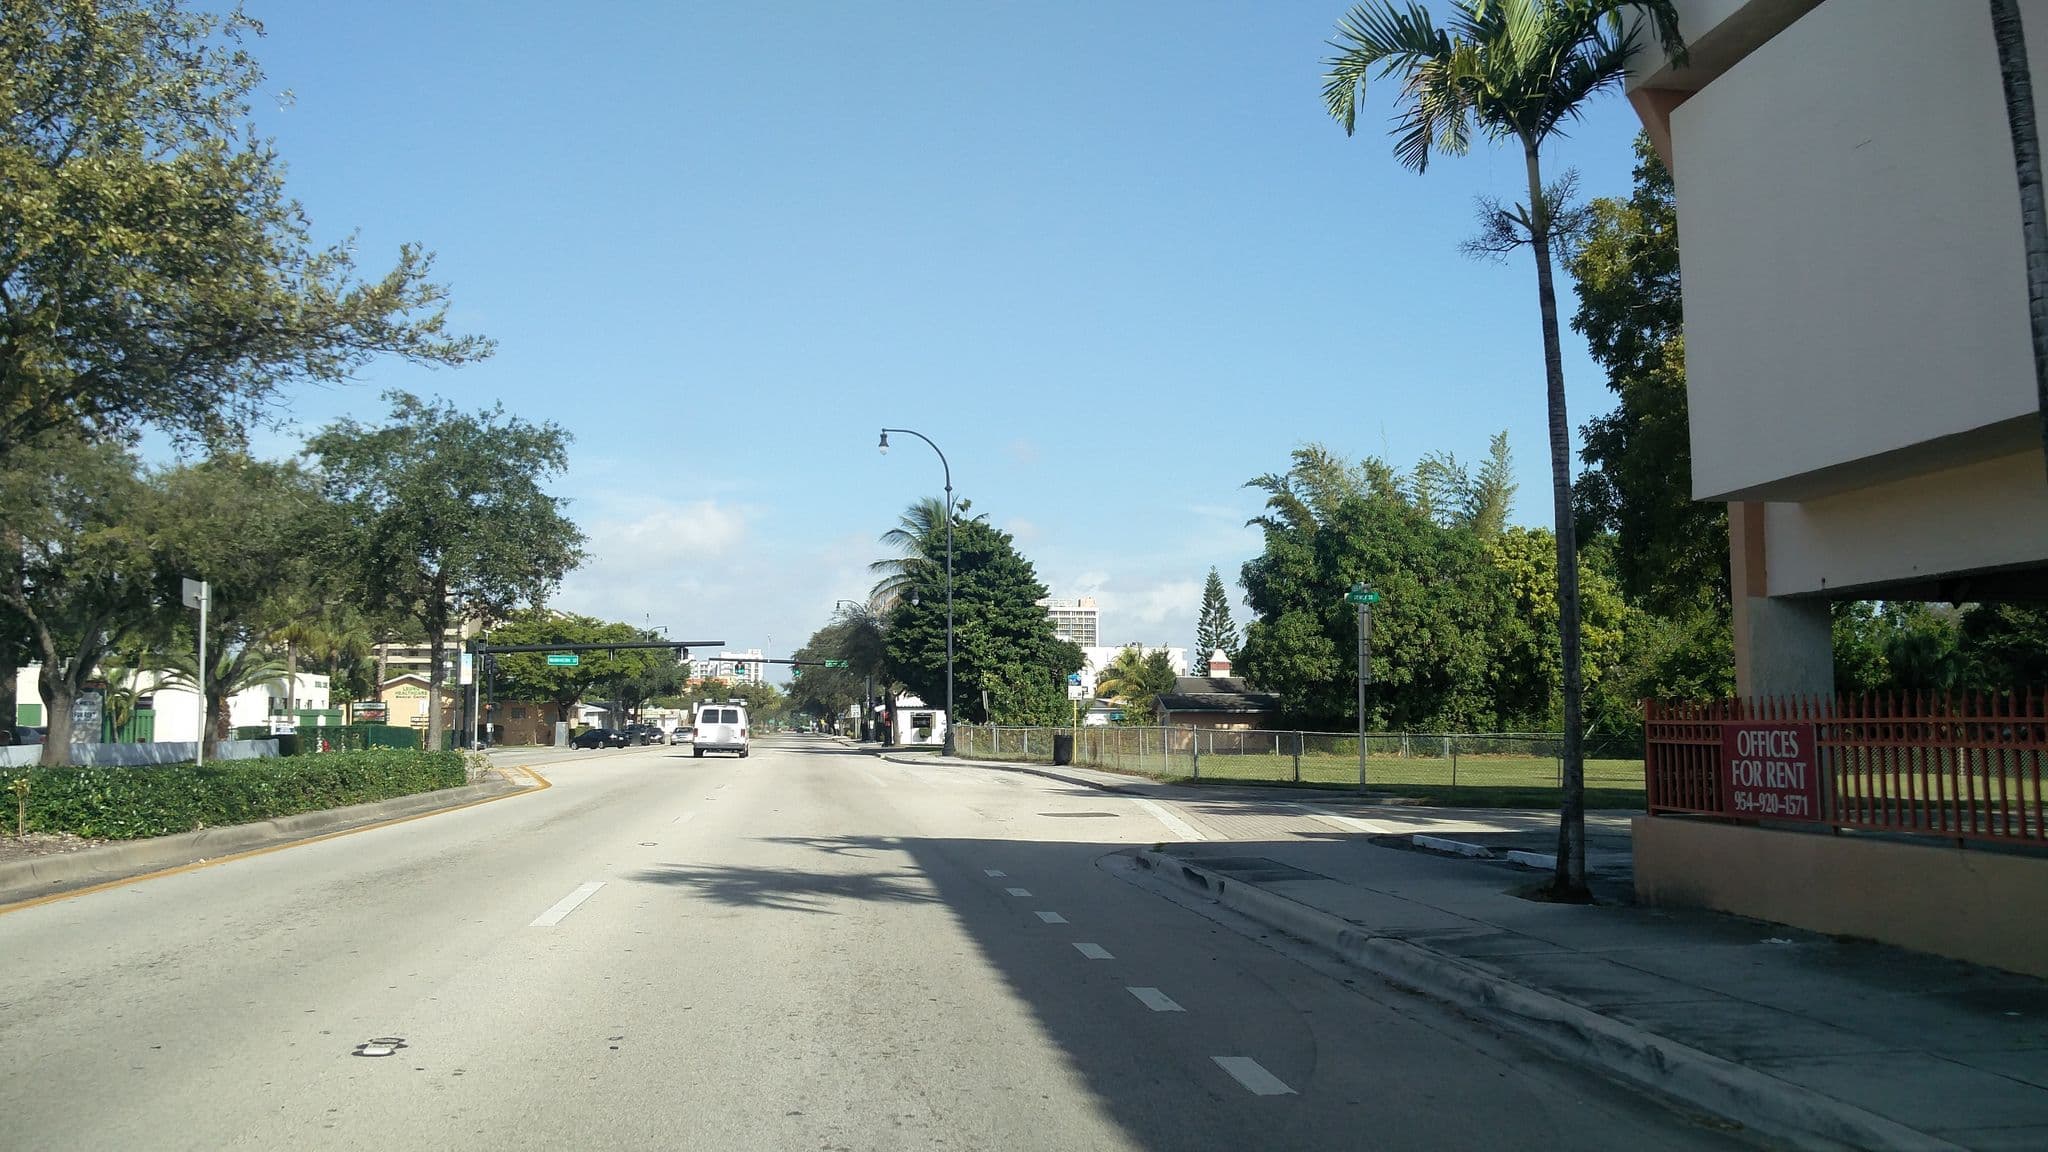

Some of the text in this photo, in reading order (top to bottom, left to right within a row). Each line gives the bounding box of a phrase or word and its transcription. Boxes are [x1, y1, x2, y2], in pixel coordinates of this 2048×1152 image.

[1737, 730, 1799, 758] OFFICES
[1732, 759, 1806, 789] FOR RENT
[1734, 791, 1808, 816] 954-920-1571
